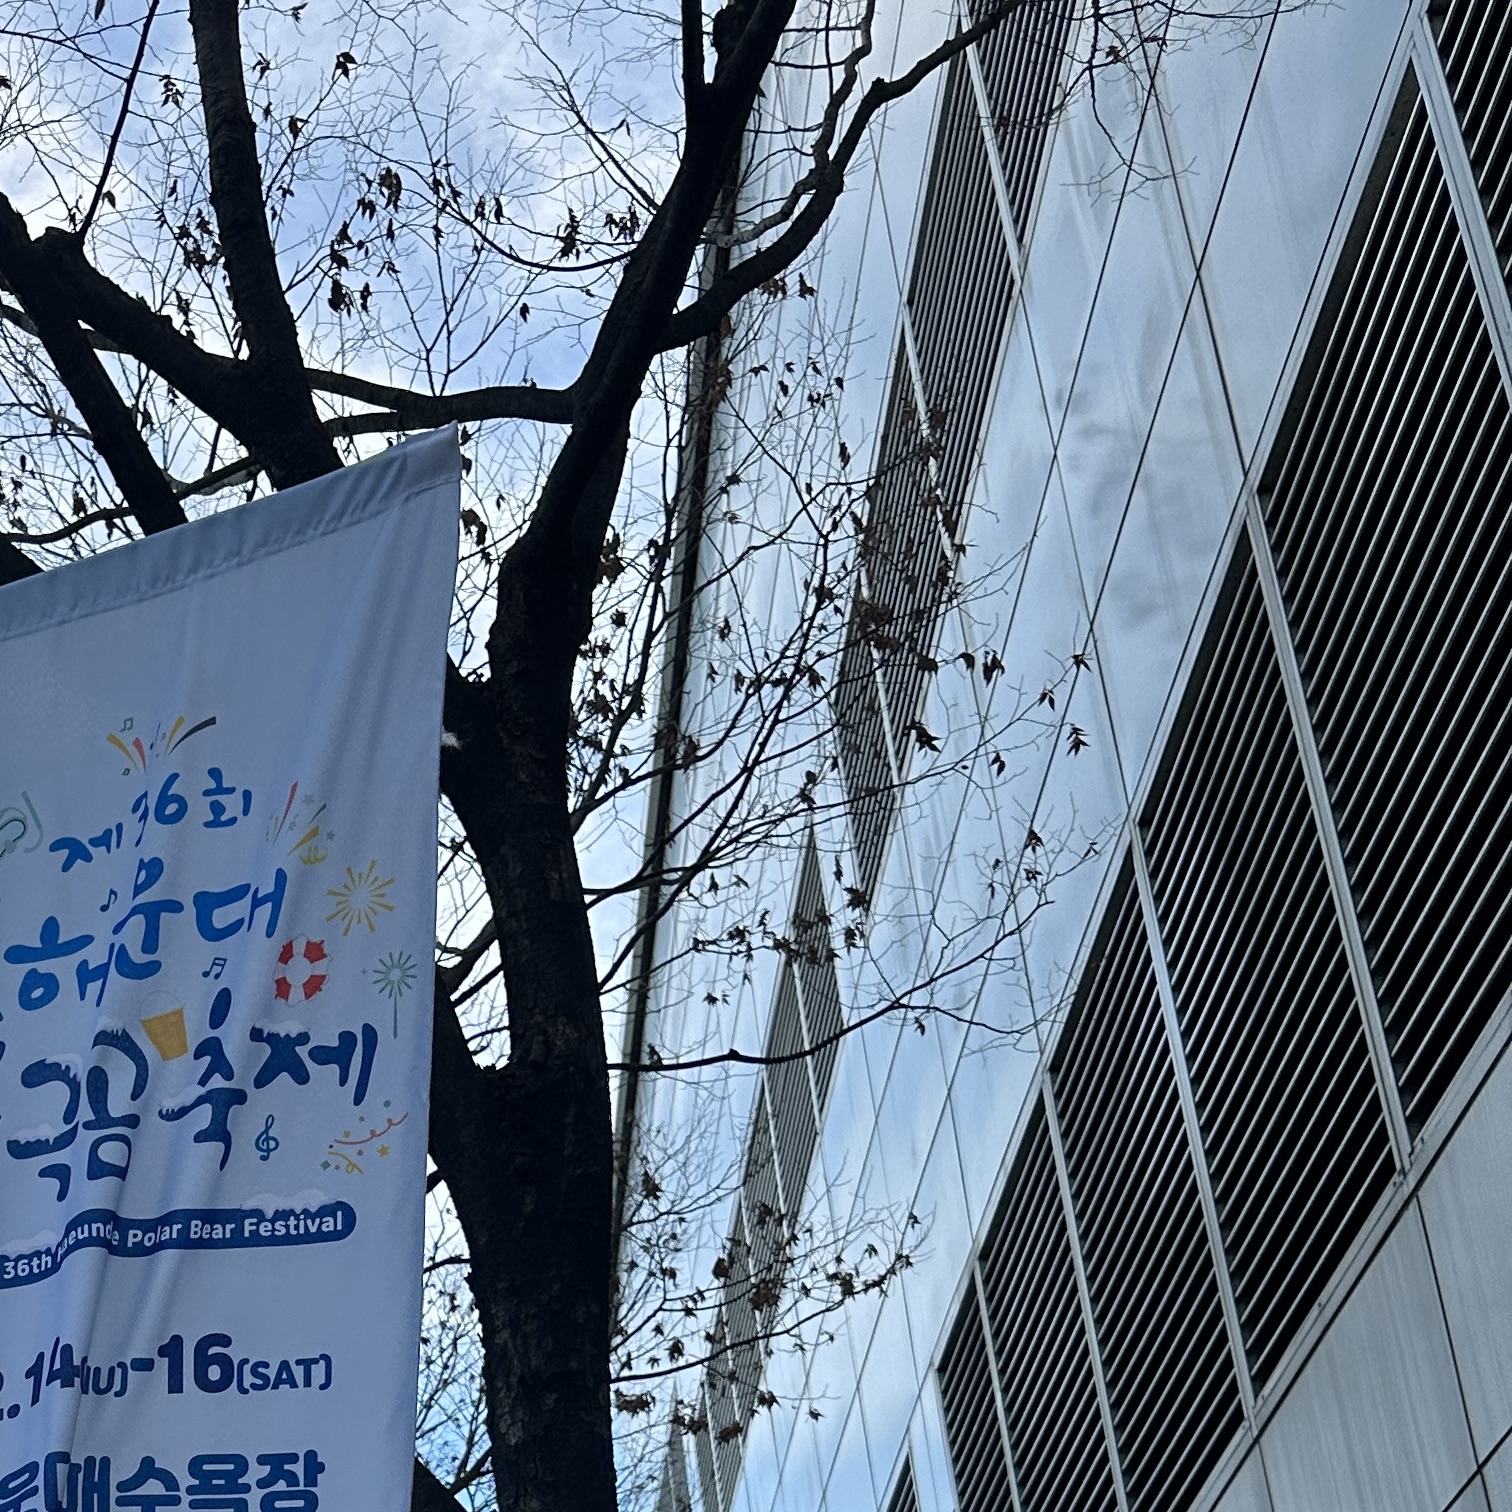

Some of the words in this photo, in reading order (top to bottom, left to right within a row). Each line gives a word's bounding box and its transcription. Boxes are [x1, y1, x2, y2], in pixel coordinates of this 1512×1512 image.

[4, 868, 287, 1011] 해운대
[3, 1251, 52, 1279] 36th
[127, 1223, 182, 1248] Polar
[190, 1219, 233, 1239] Bear
[243, 1211, 343, 1237] Festival
